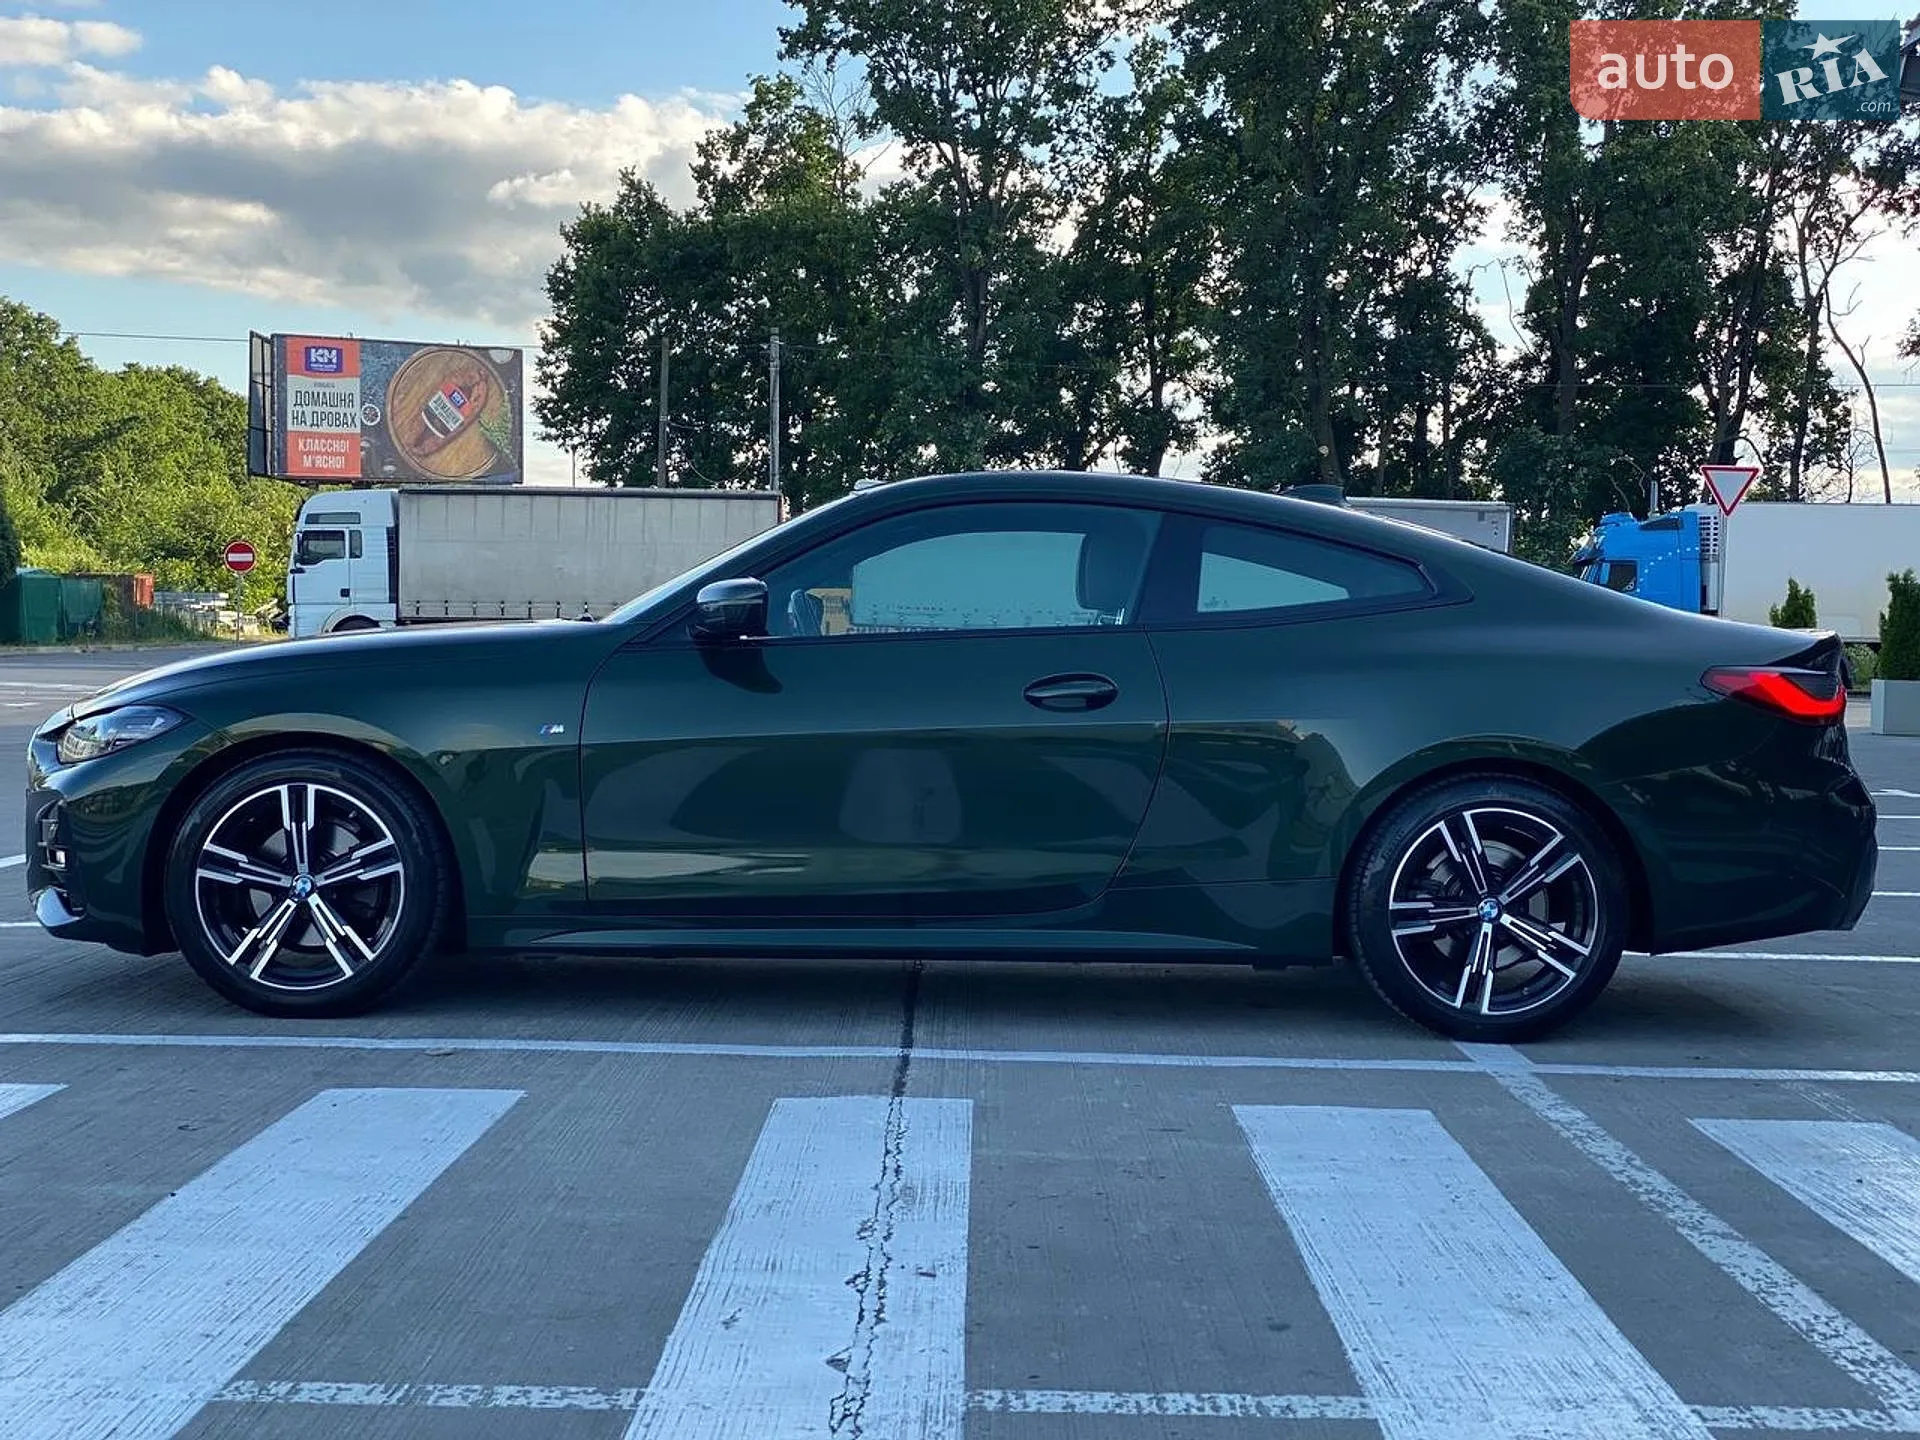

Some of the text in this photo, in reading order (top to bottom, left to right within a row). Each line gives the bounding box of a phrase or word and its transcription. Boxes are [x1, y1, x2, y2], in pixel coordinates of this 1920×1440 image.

[293, 390, 354, 409] ДОМАШНЯ
[291, 409, 357, 429] НА ДРОВАХ
